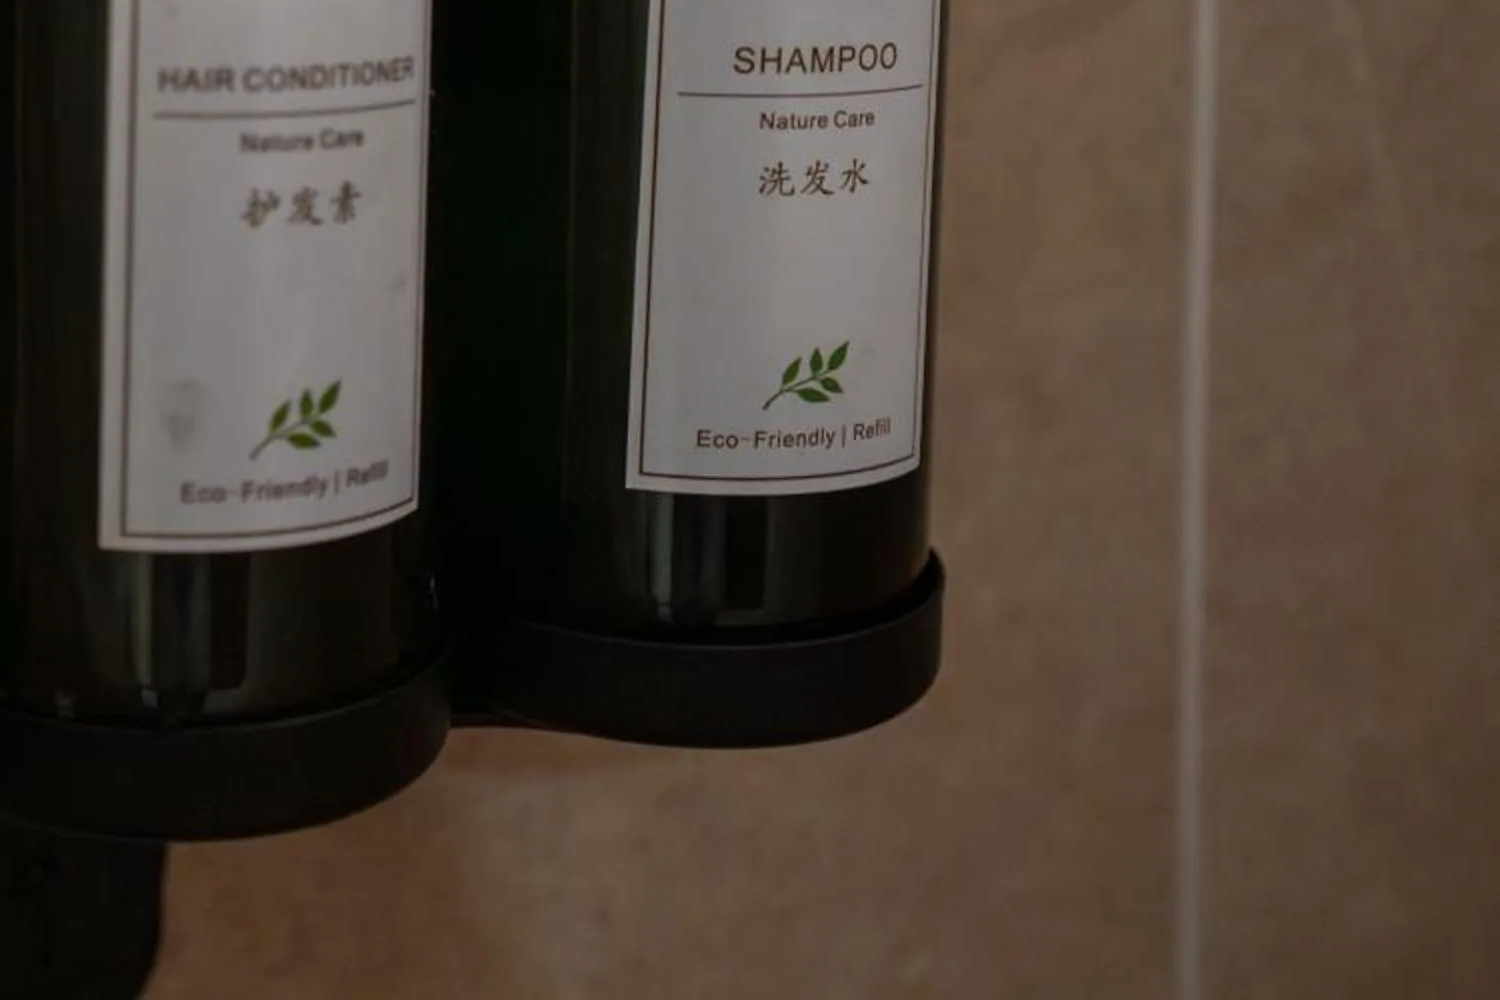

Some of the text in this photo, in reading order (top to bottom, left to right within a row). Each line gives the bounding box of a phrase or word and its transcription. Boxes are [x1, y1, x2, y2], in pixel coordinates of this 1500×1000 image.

[157, 55, 415, 93] HAIR CONDITIONER
[732, 42, 898, 75] SHAMPOO
[759, 109, 876, 130] Nature Care
[320, 127, 365, 149] Care
[758, 158, 869, 197] 洗发水
[695, 427, 836, 450] Eco-Friendly
[853, 418, 891, 442] Refill
